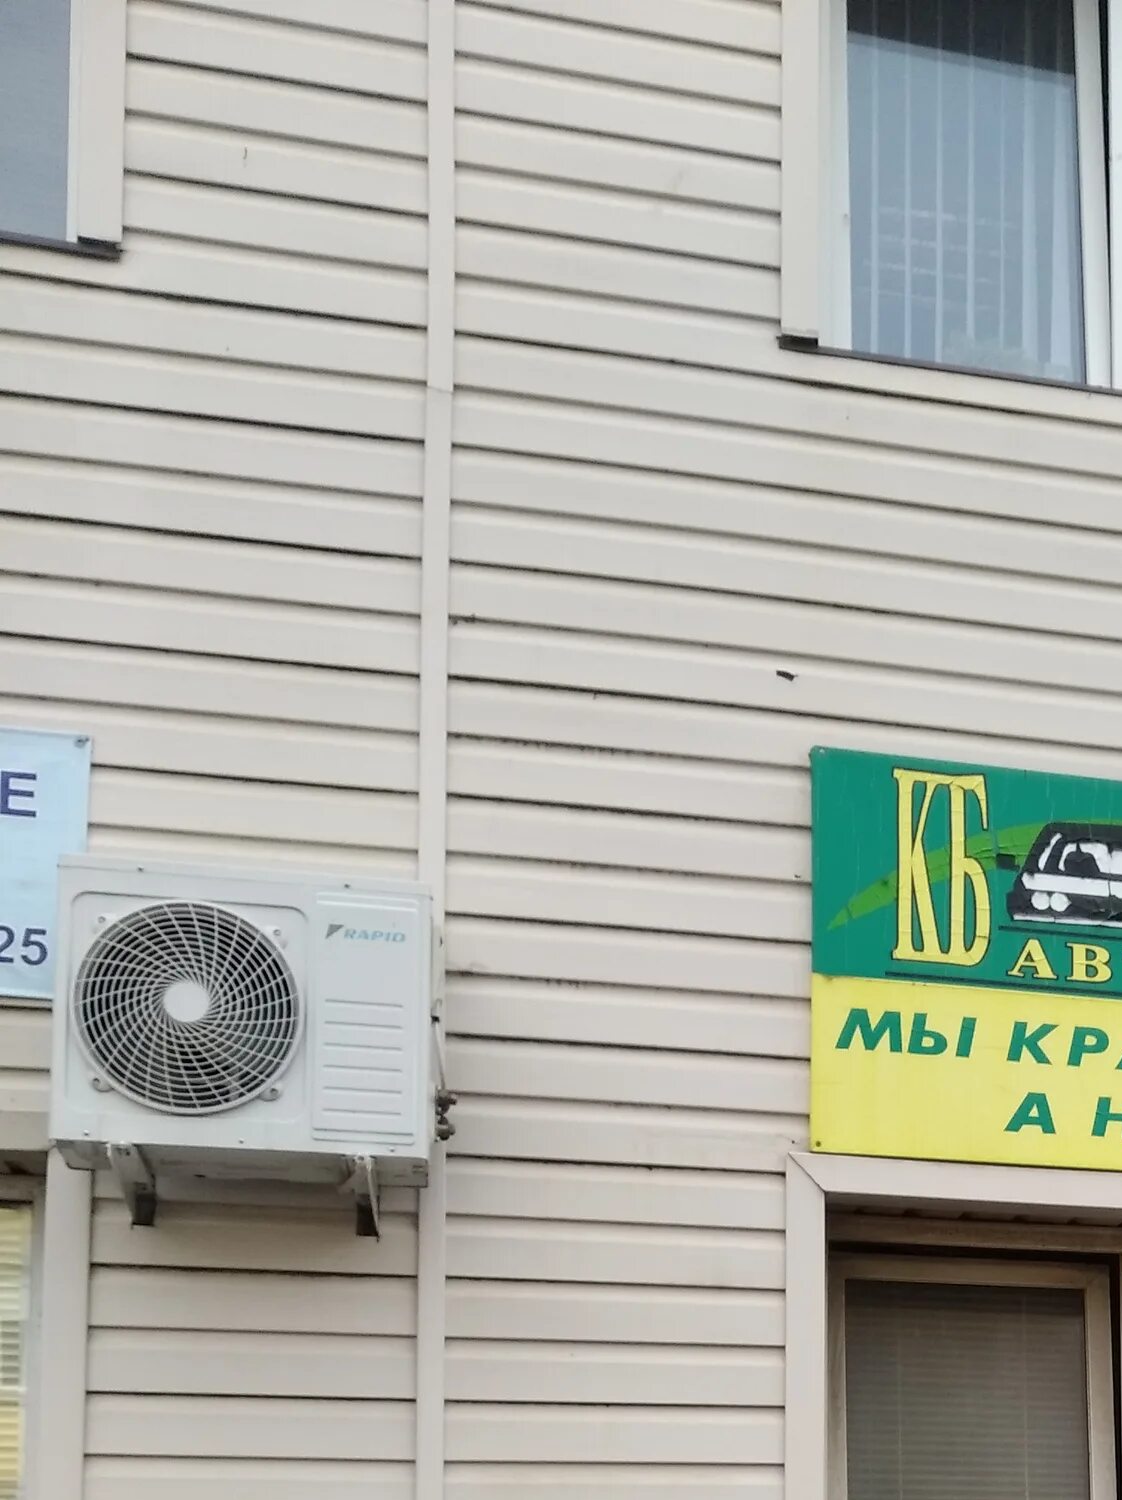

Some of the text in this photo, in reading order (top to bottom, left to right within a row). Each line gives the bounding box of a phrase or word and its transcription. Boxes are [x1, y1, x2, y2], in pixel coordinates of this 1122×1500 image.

[891, 767, 991, 967] КБ
[834, 1007, 977, 1059] МЫ
[1004, 1091, 1056, 1135] А
